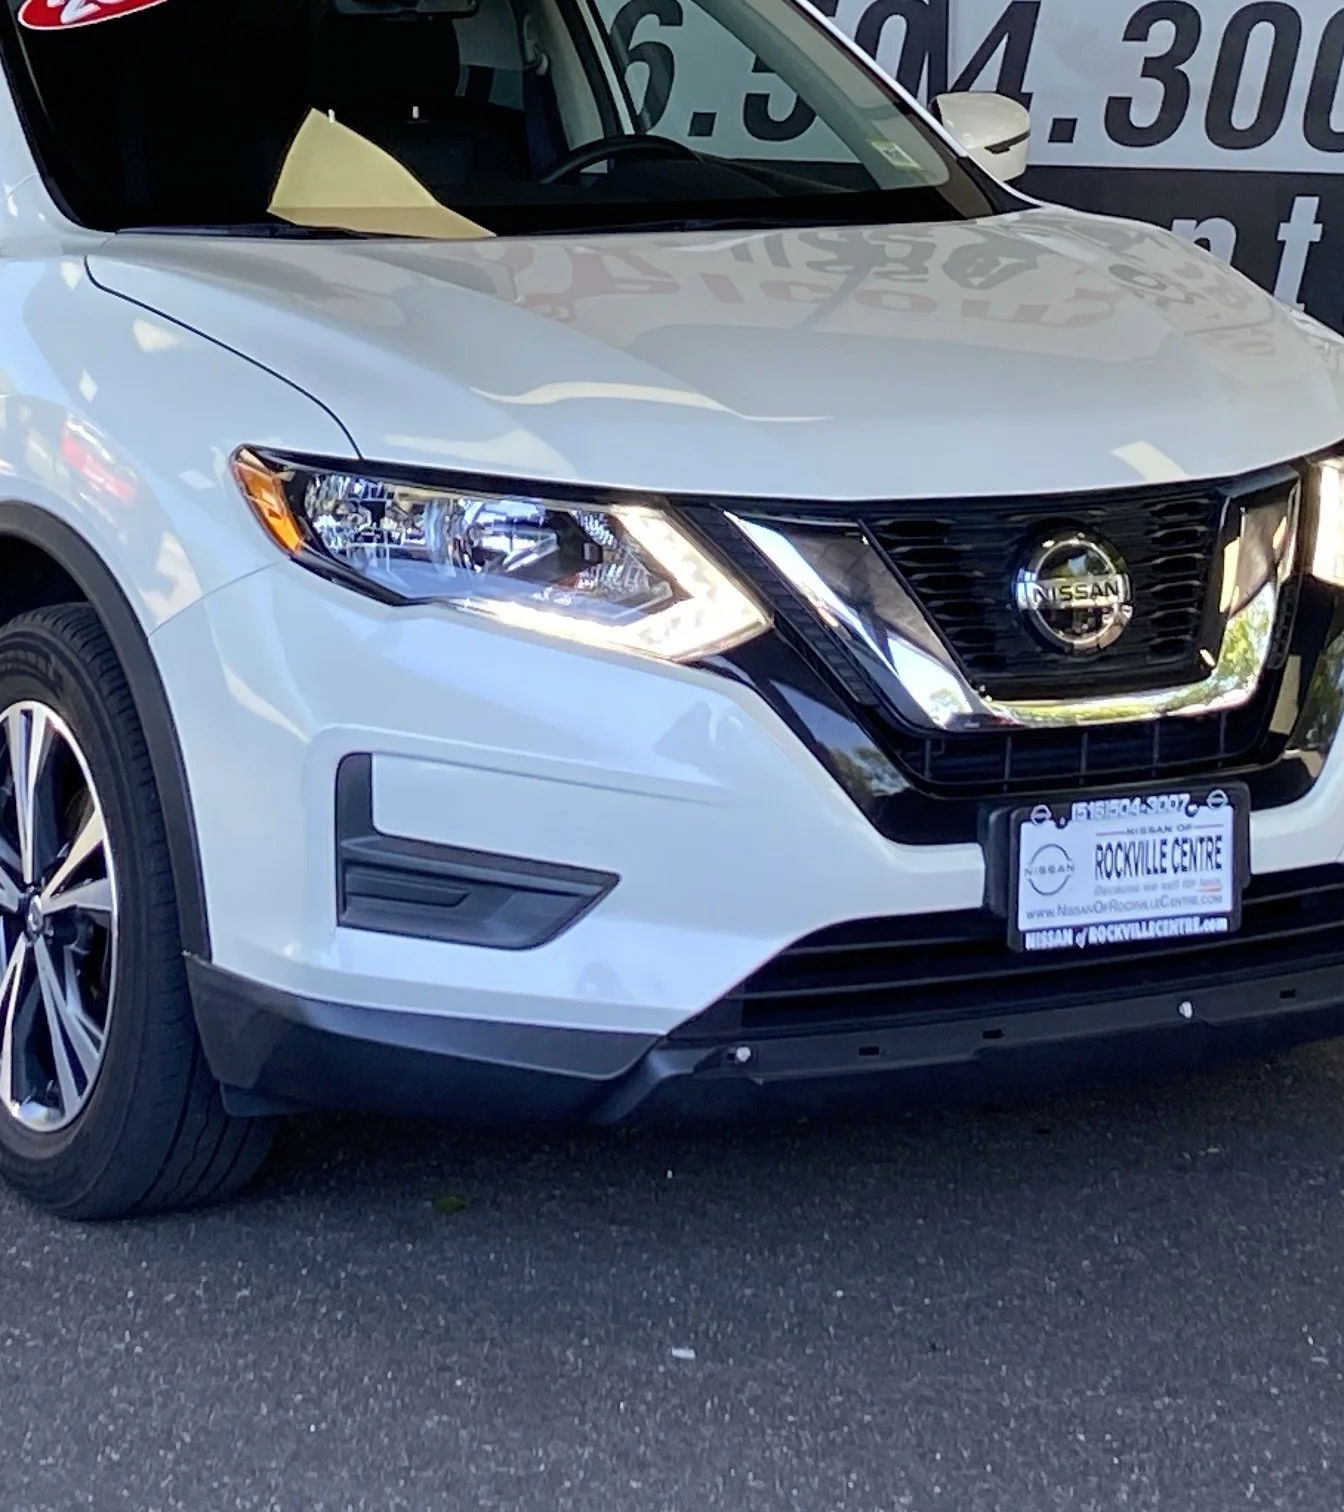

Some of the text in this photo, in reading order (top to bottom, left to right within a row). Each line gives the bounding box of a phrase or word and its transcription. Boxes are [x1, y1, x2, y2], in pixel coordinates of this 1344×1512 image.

[1033, 580, 1119, 606] NISSAN
[1094, 835, 1223, 880] ROCKVILLE CENTRE
